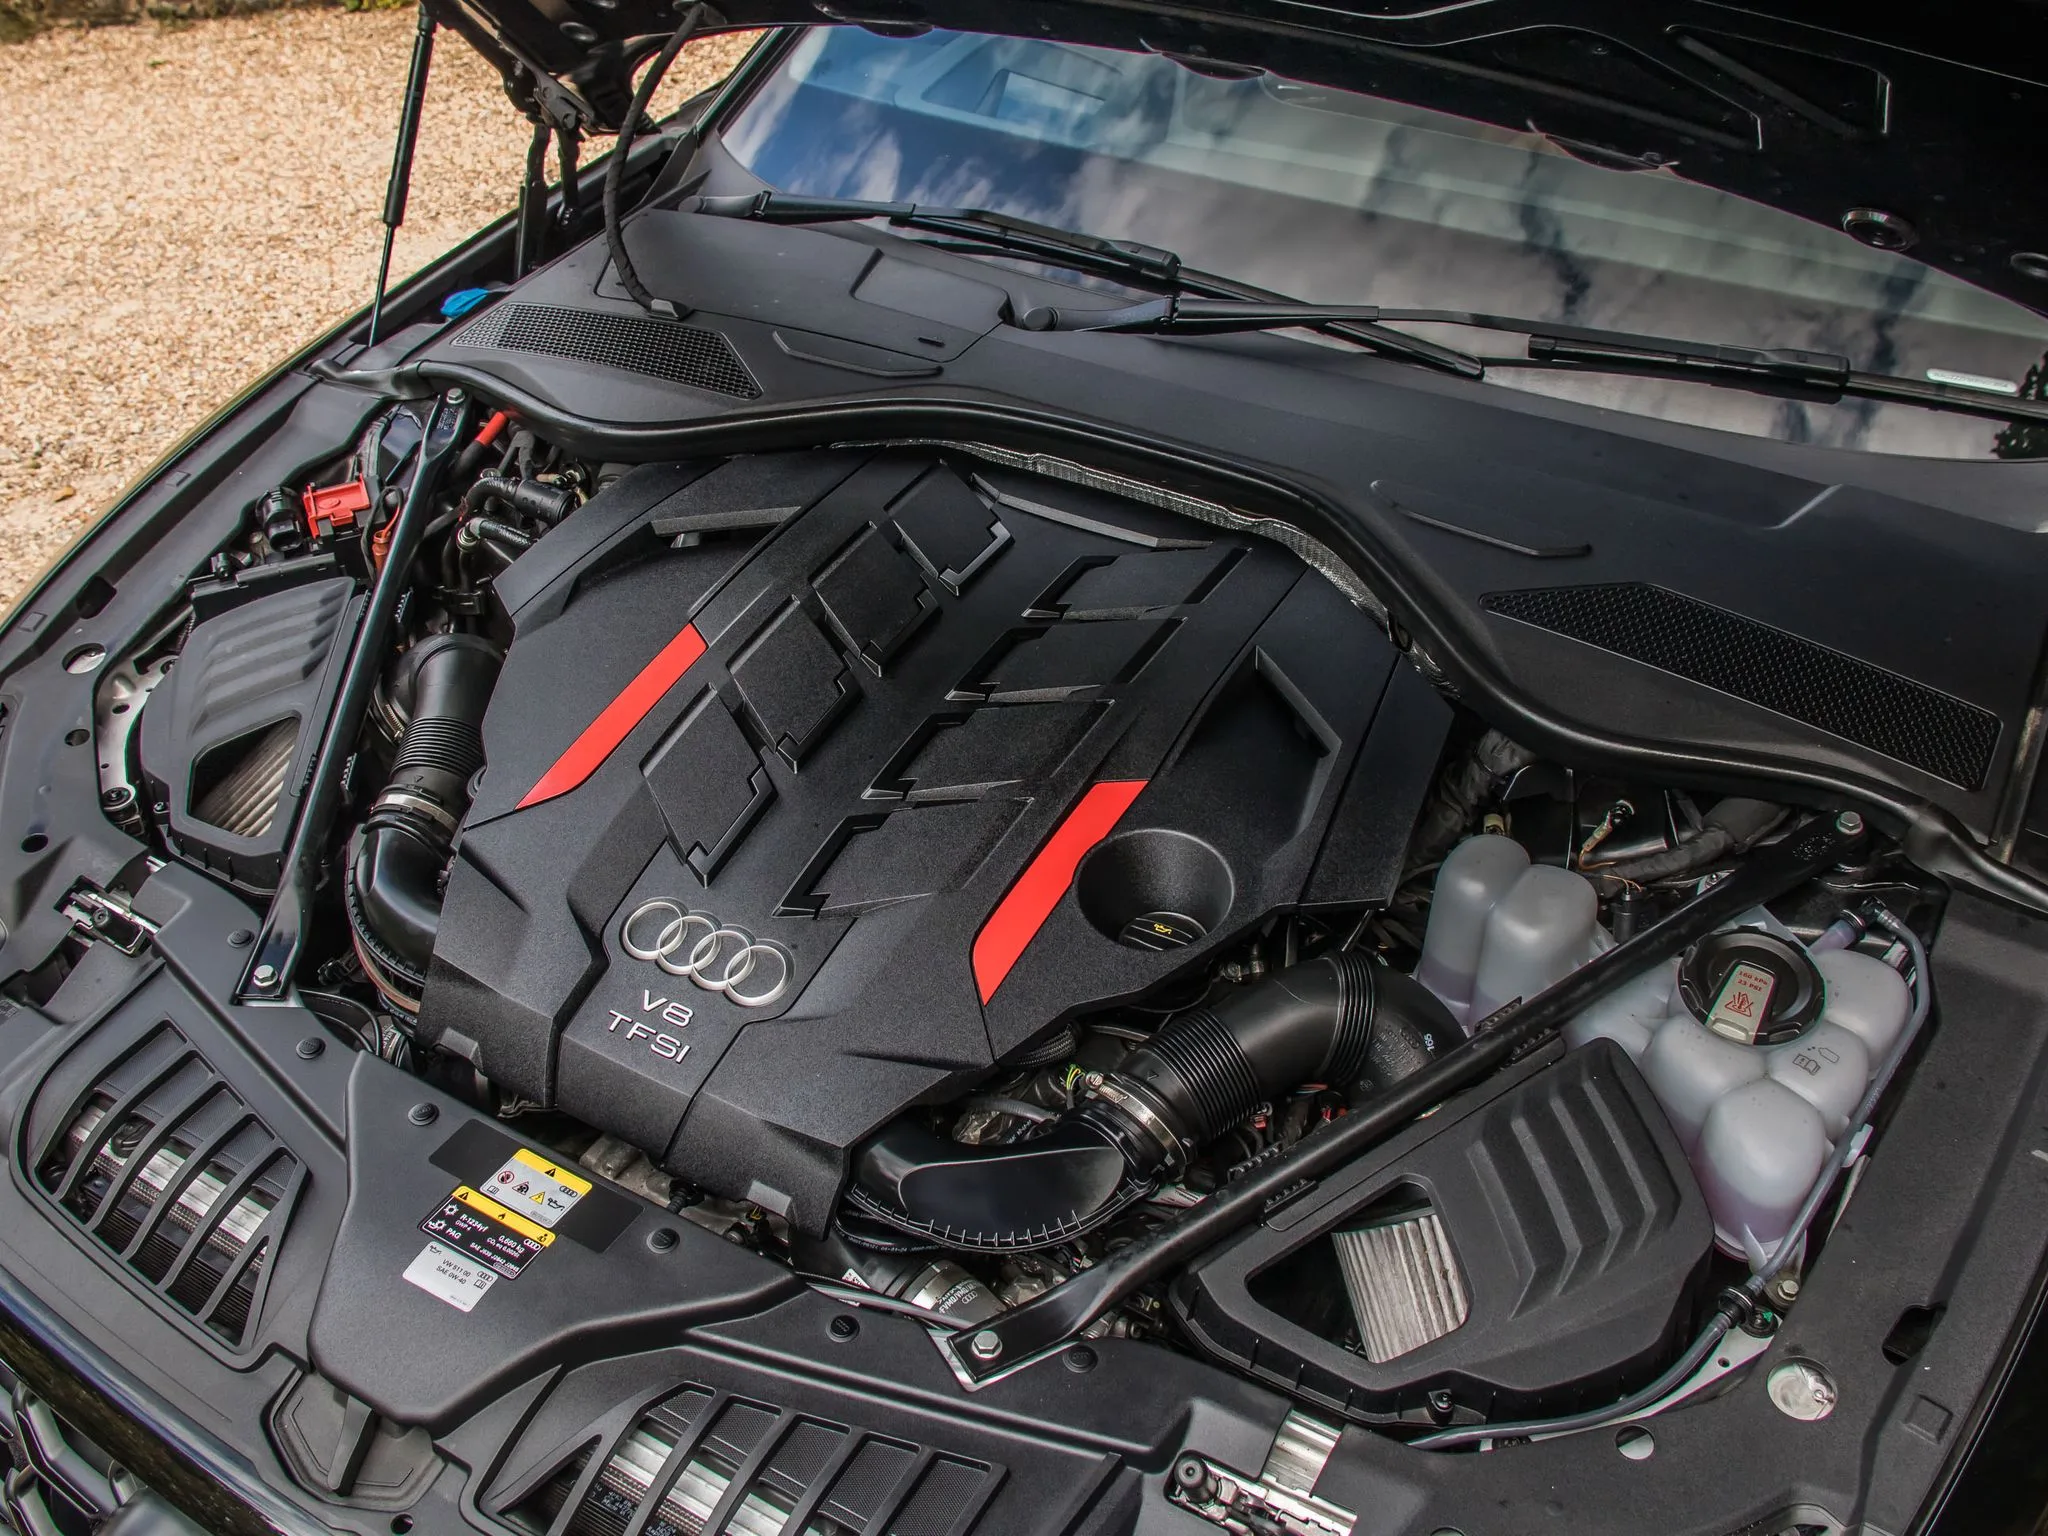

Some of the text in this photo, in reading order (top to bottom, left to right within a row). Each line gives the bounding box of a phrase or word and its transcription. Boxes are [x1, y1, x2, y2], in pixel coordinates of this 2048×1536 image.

[643, 989, 694, 1028] V8
[608, 1009, 691, 1064] TFSI
[460, 1214, 488, 1231] R-1234yf
[446, 1228, 461, 1239] PAG
[516, 1244, 526, 1254] kg
[443, 1259, 454, 1268] VW
[453, 1264, 463, 1273] 511
[436, 1265, 467, 1285] SAE 0W-40
